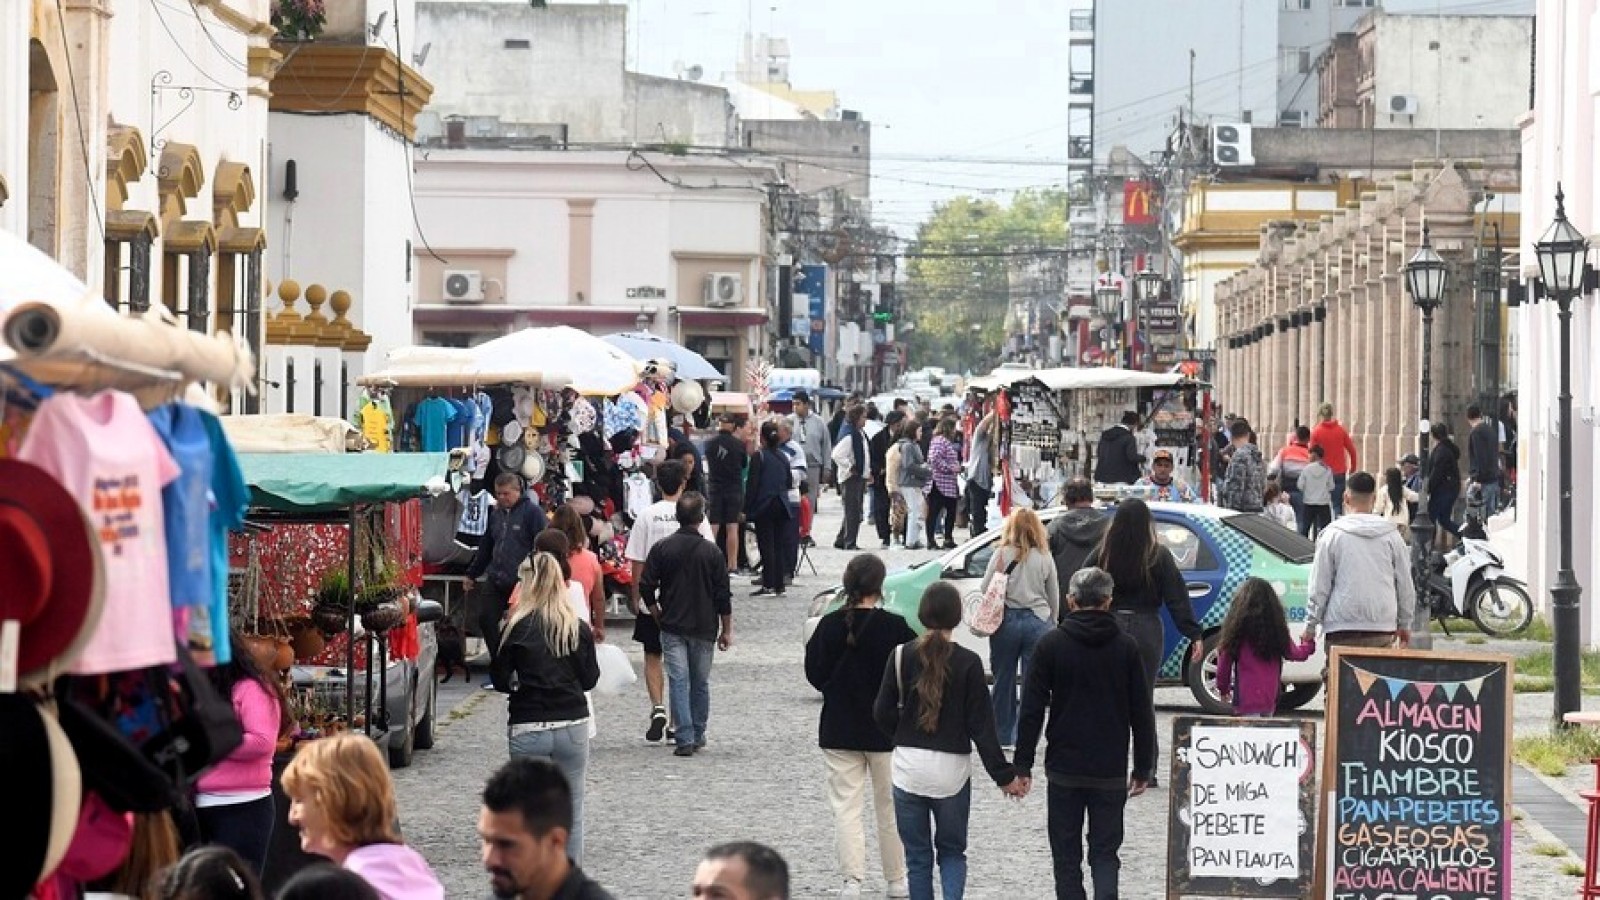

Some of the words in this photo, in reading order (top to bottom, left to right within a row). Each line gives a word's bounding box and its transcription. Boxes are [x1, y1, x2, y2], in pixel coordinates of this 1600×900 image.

[1356, 699, 1482, 733] ALMACEN
[1196, 737, 1297, 769] SANDWICH
[1193, 784, 1218, 806] DE
[1339, 797, 1499, 825] PAN-PEBETES
[1194, 813, 1265, 836] PEBETE
[1338, 824, 1489, 850] GASEOSAS
[1193, 849, 1231, 867] PAN
[1236, 850, 1295, 869] FLAUTA
[1335, 867, 1397, 890] AGUA
[1399, 867, 1498, 894] CALIENTE
